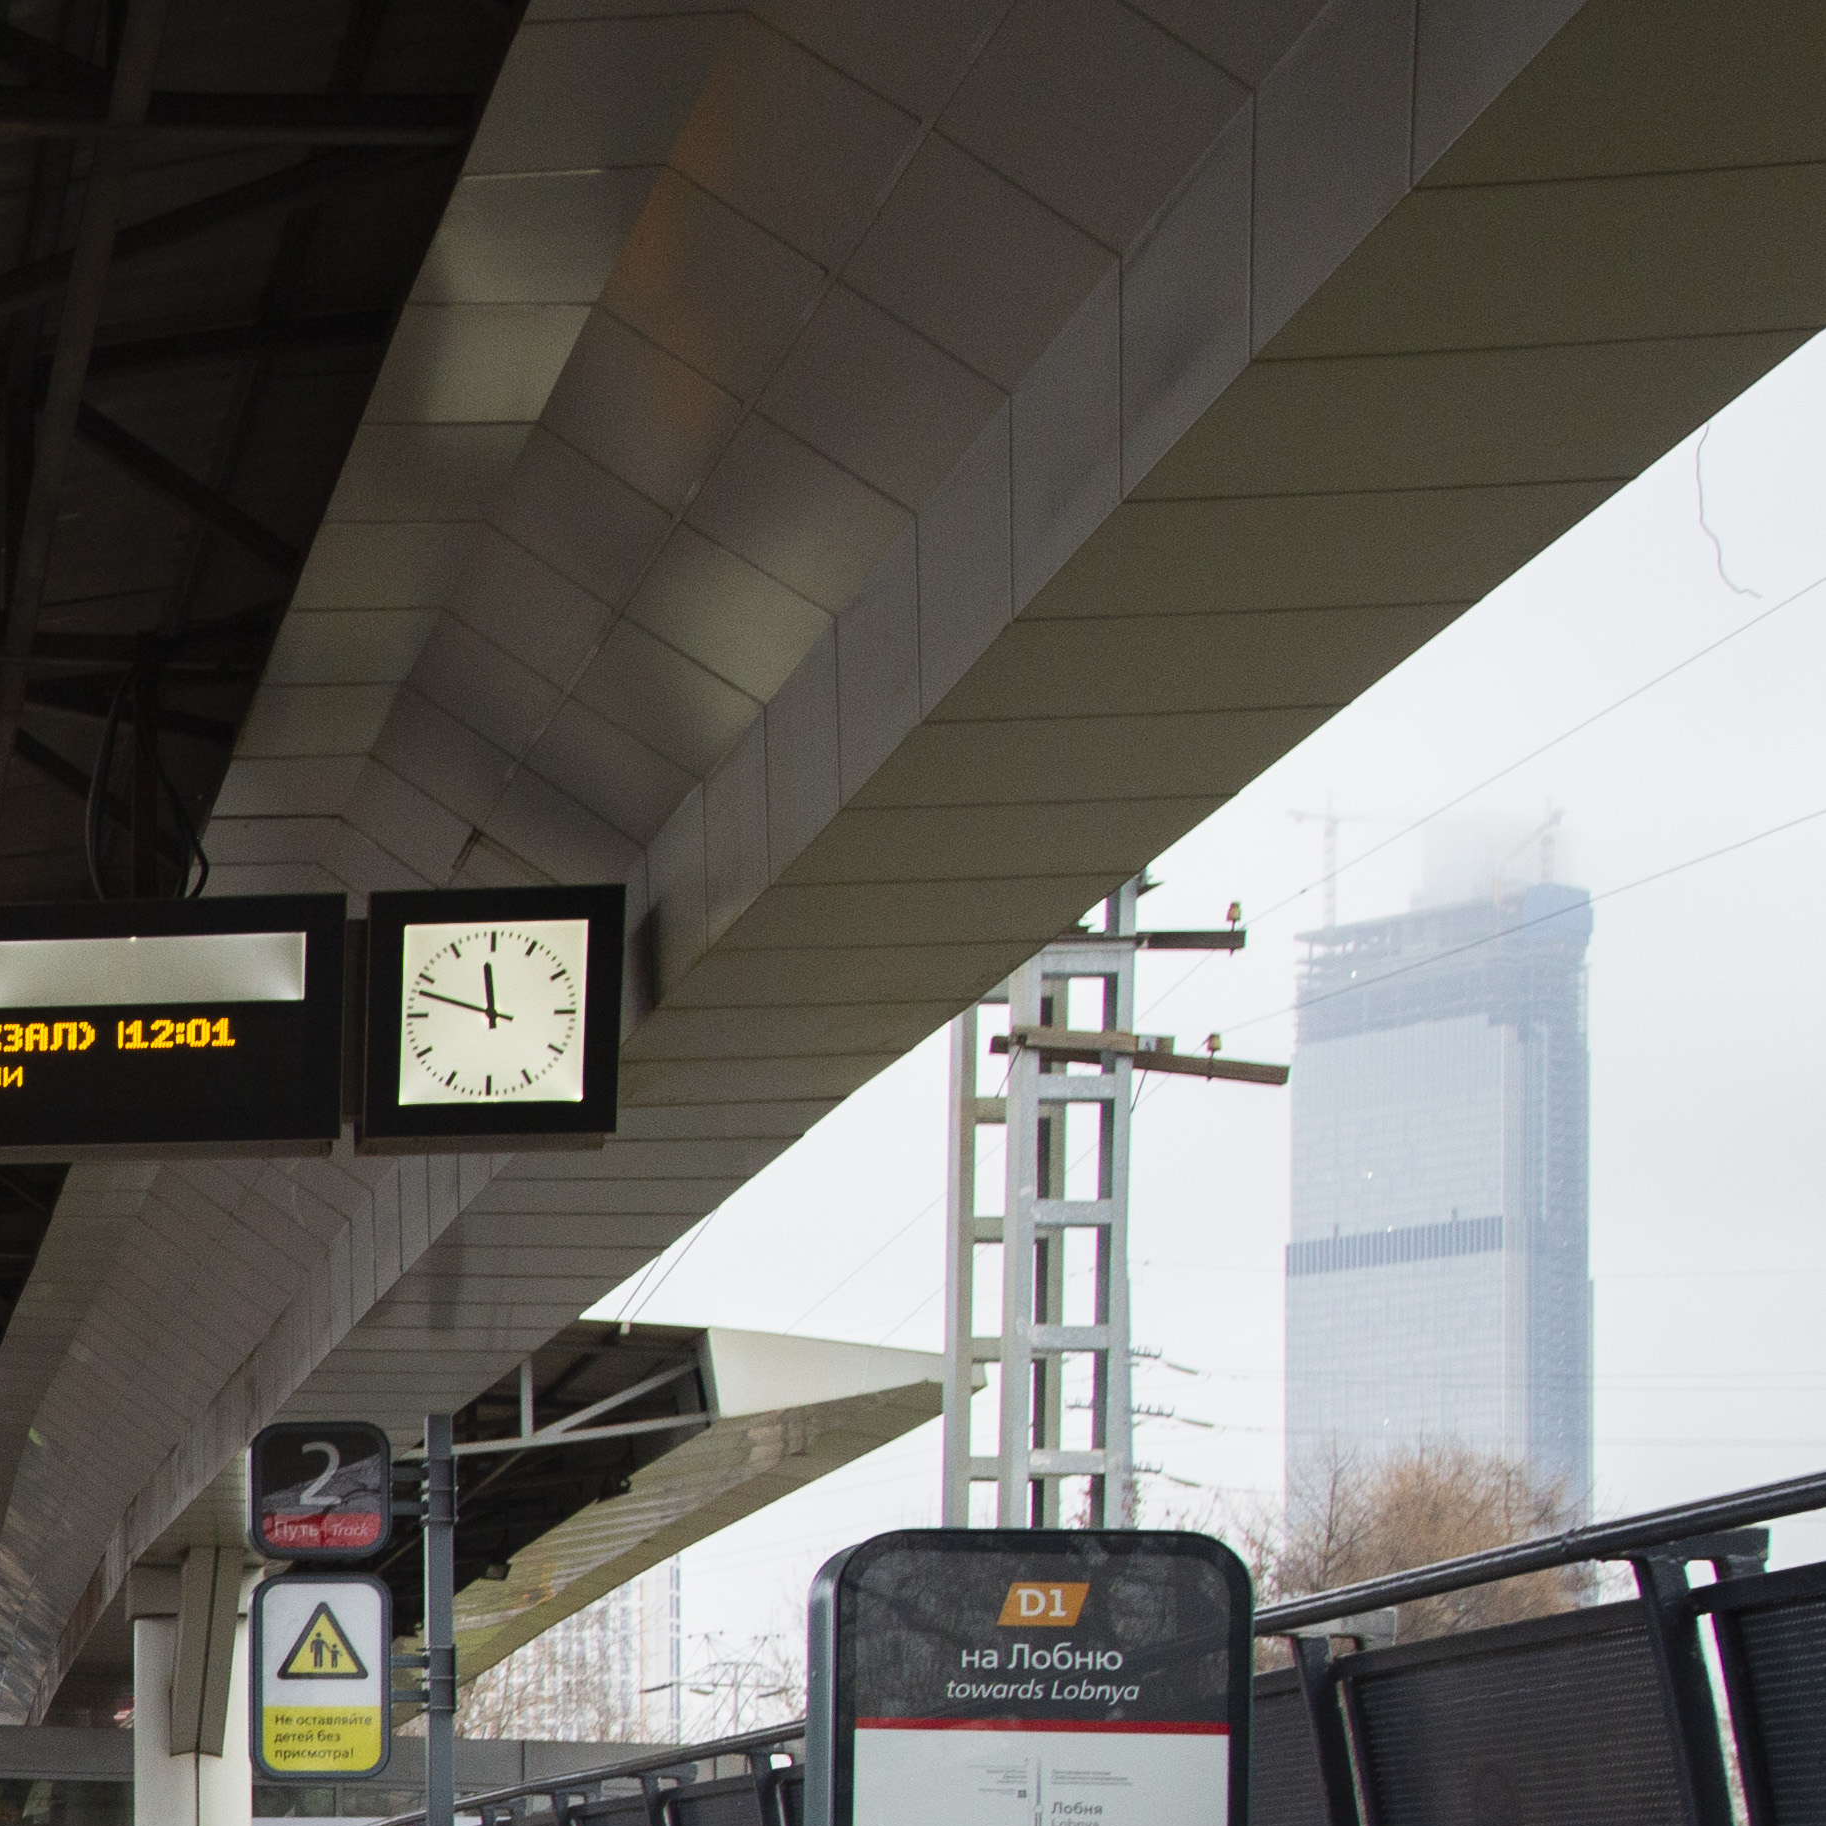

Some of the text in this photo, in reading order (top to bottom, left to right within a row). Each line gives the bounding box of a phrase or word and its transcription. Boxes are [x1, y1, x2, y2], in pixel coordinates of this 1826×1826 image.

[300, 1441, 341, 1506] 2
[274, 1521, 320, 1541] Путь
[333, 1521, 369, 1536] Track
[1016, 1588, 1068, 1617] D1
[961, 1642, 1124, 1671] на Лобню
[946, 1678, 1141, 1706] towards Lobnya
[275, 1712, 373, 1726] Не оставляйте
[274, 1730, 341, 1743] детей без
[275, 1747, 355, 1761] присмотра!
[1051, 1801, 1104, 1815] Лобня
